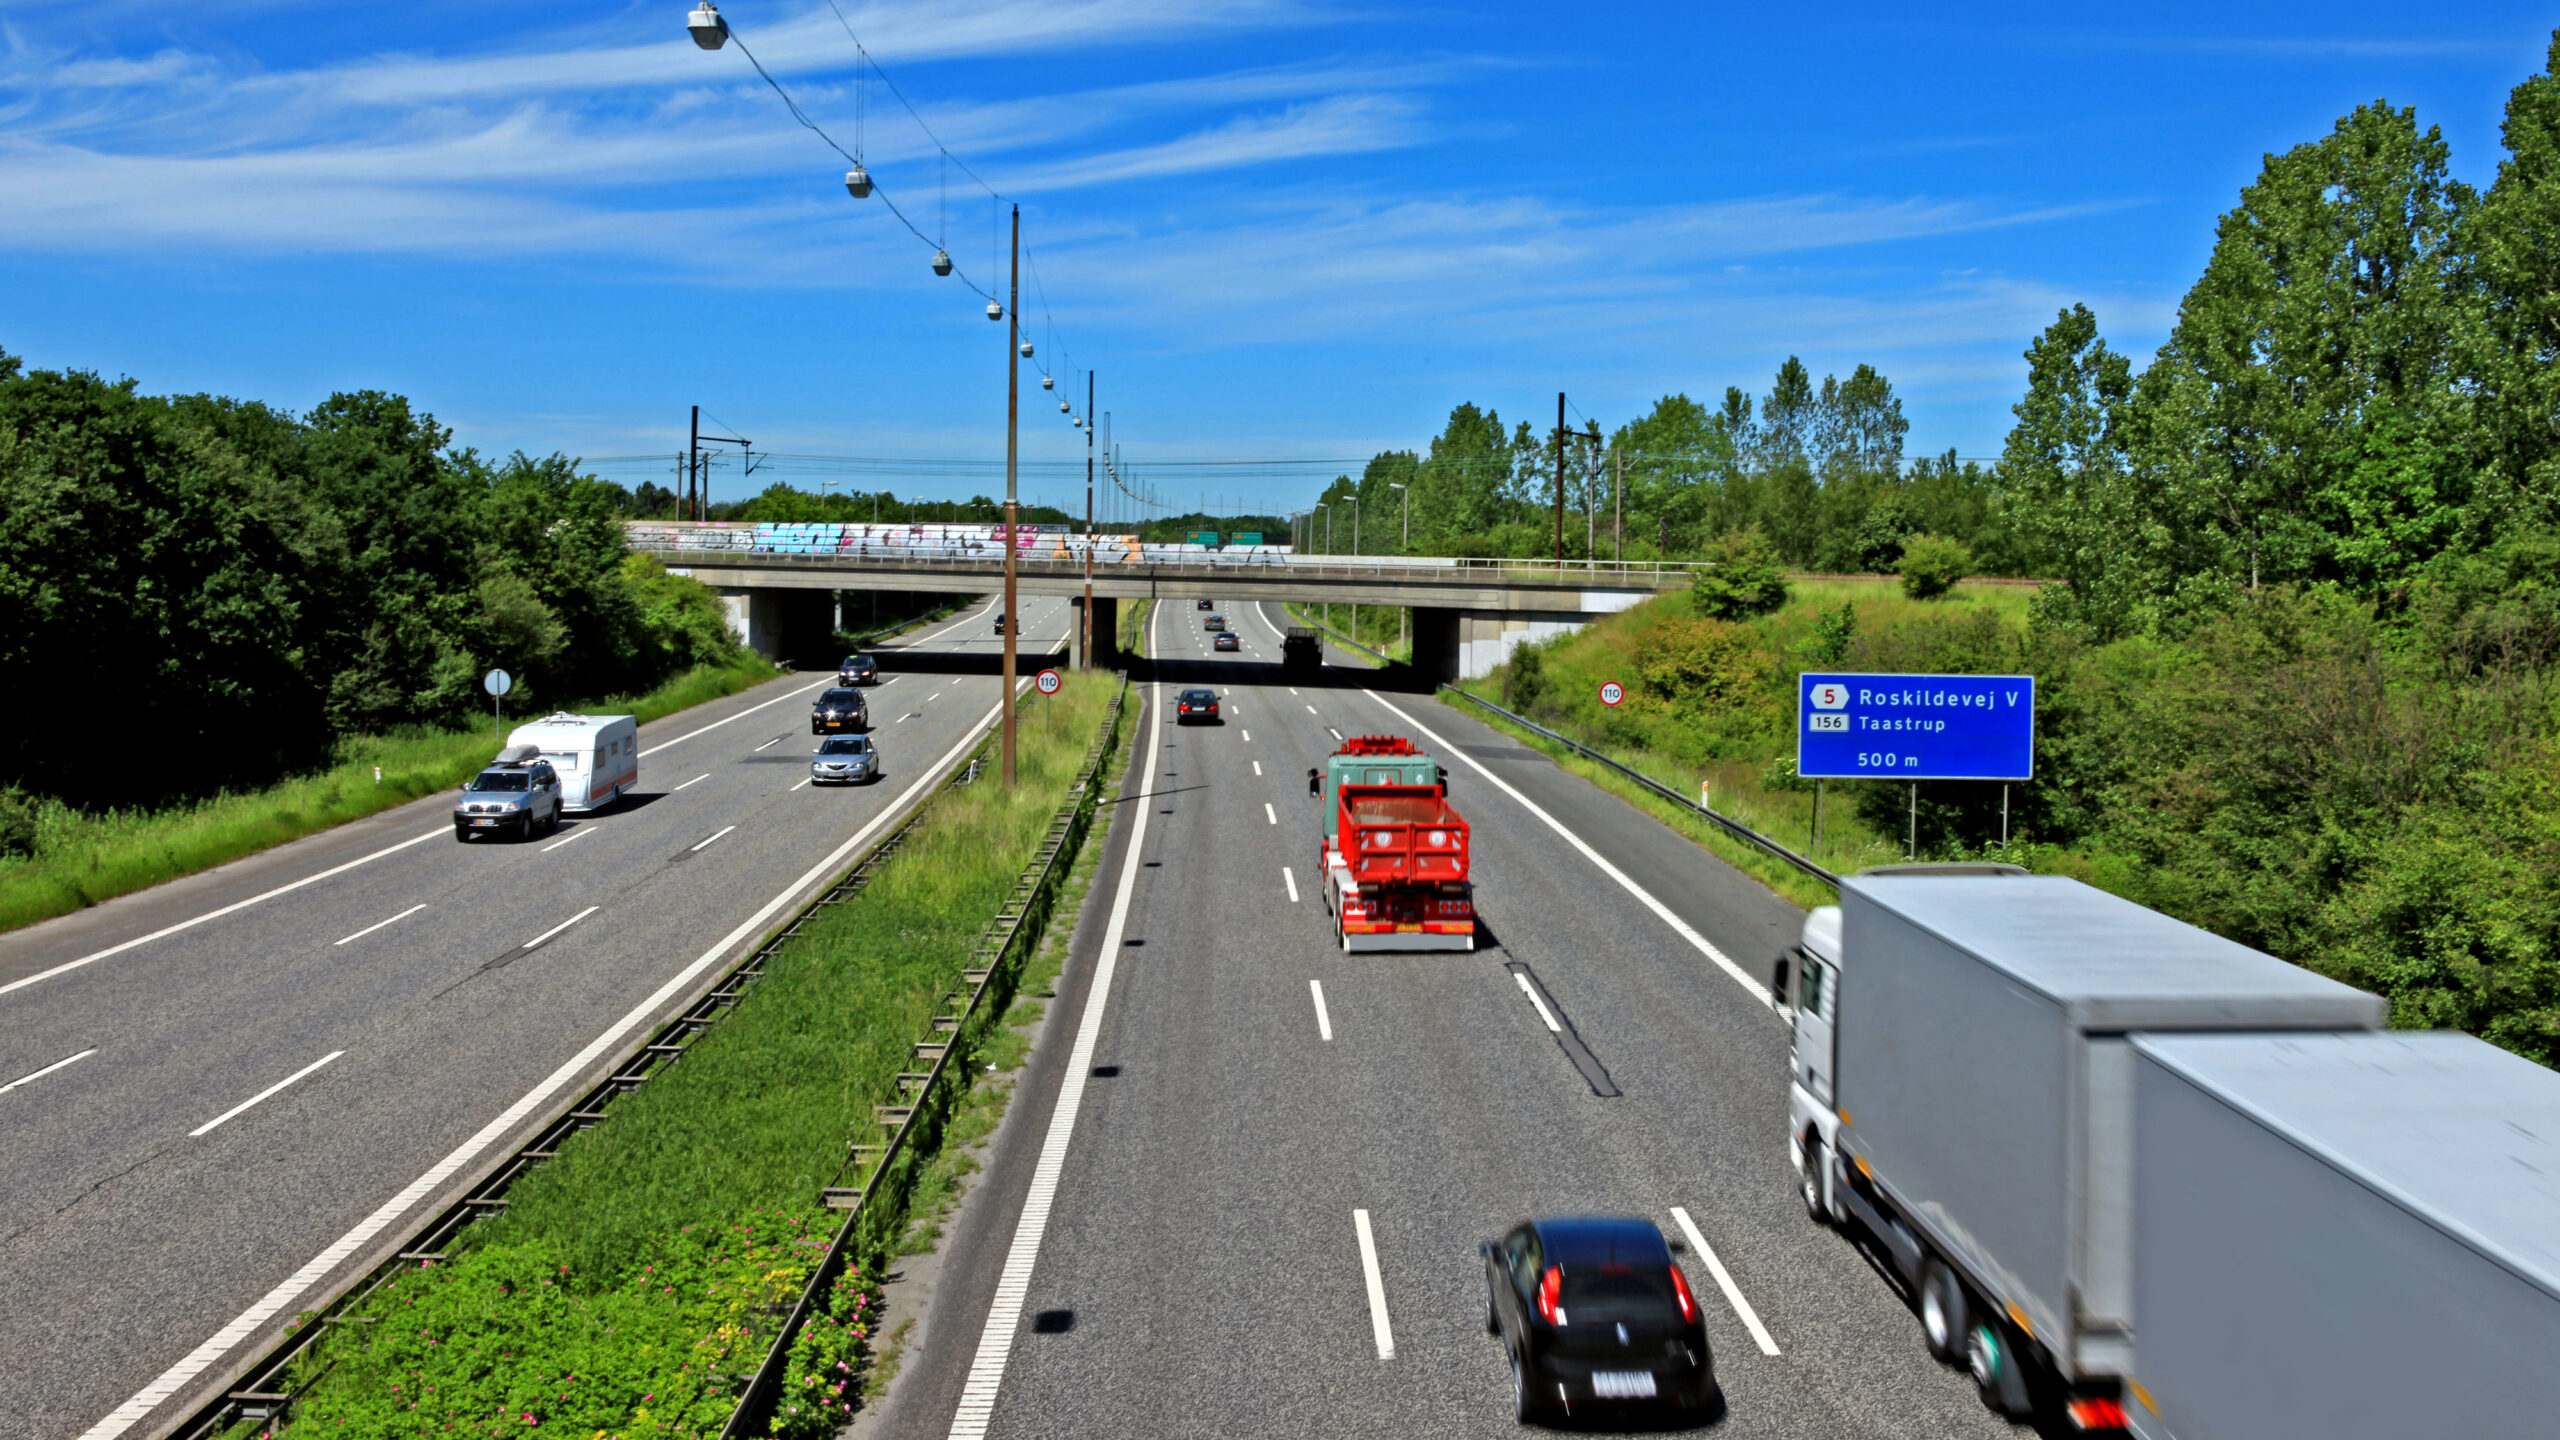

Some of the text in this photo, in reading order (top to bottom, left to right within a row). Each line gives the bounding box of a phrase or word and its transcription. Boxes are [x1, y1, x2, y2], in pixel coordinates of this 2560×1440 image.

[1040, 677, 1057, 687] 110
[1604, 689, 1620, 698] 110
[1824, 689, 1835, 704] 5
[1860, 689, 2018, 710] Roskildevej V
[1816, 717, 1842, 728] 156
[1859, 716, 1945, 733] Taastrup
[1858, 752, 1918, 767] 500 m
